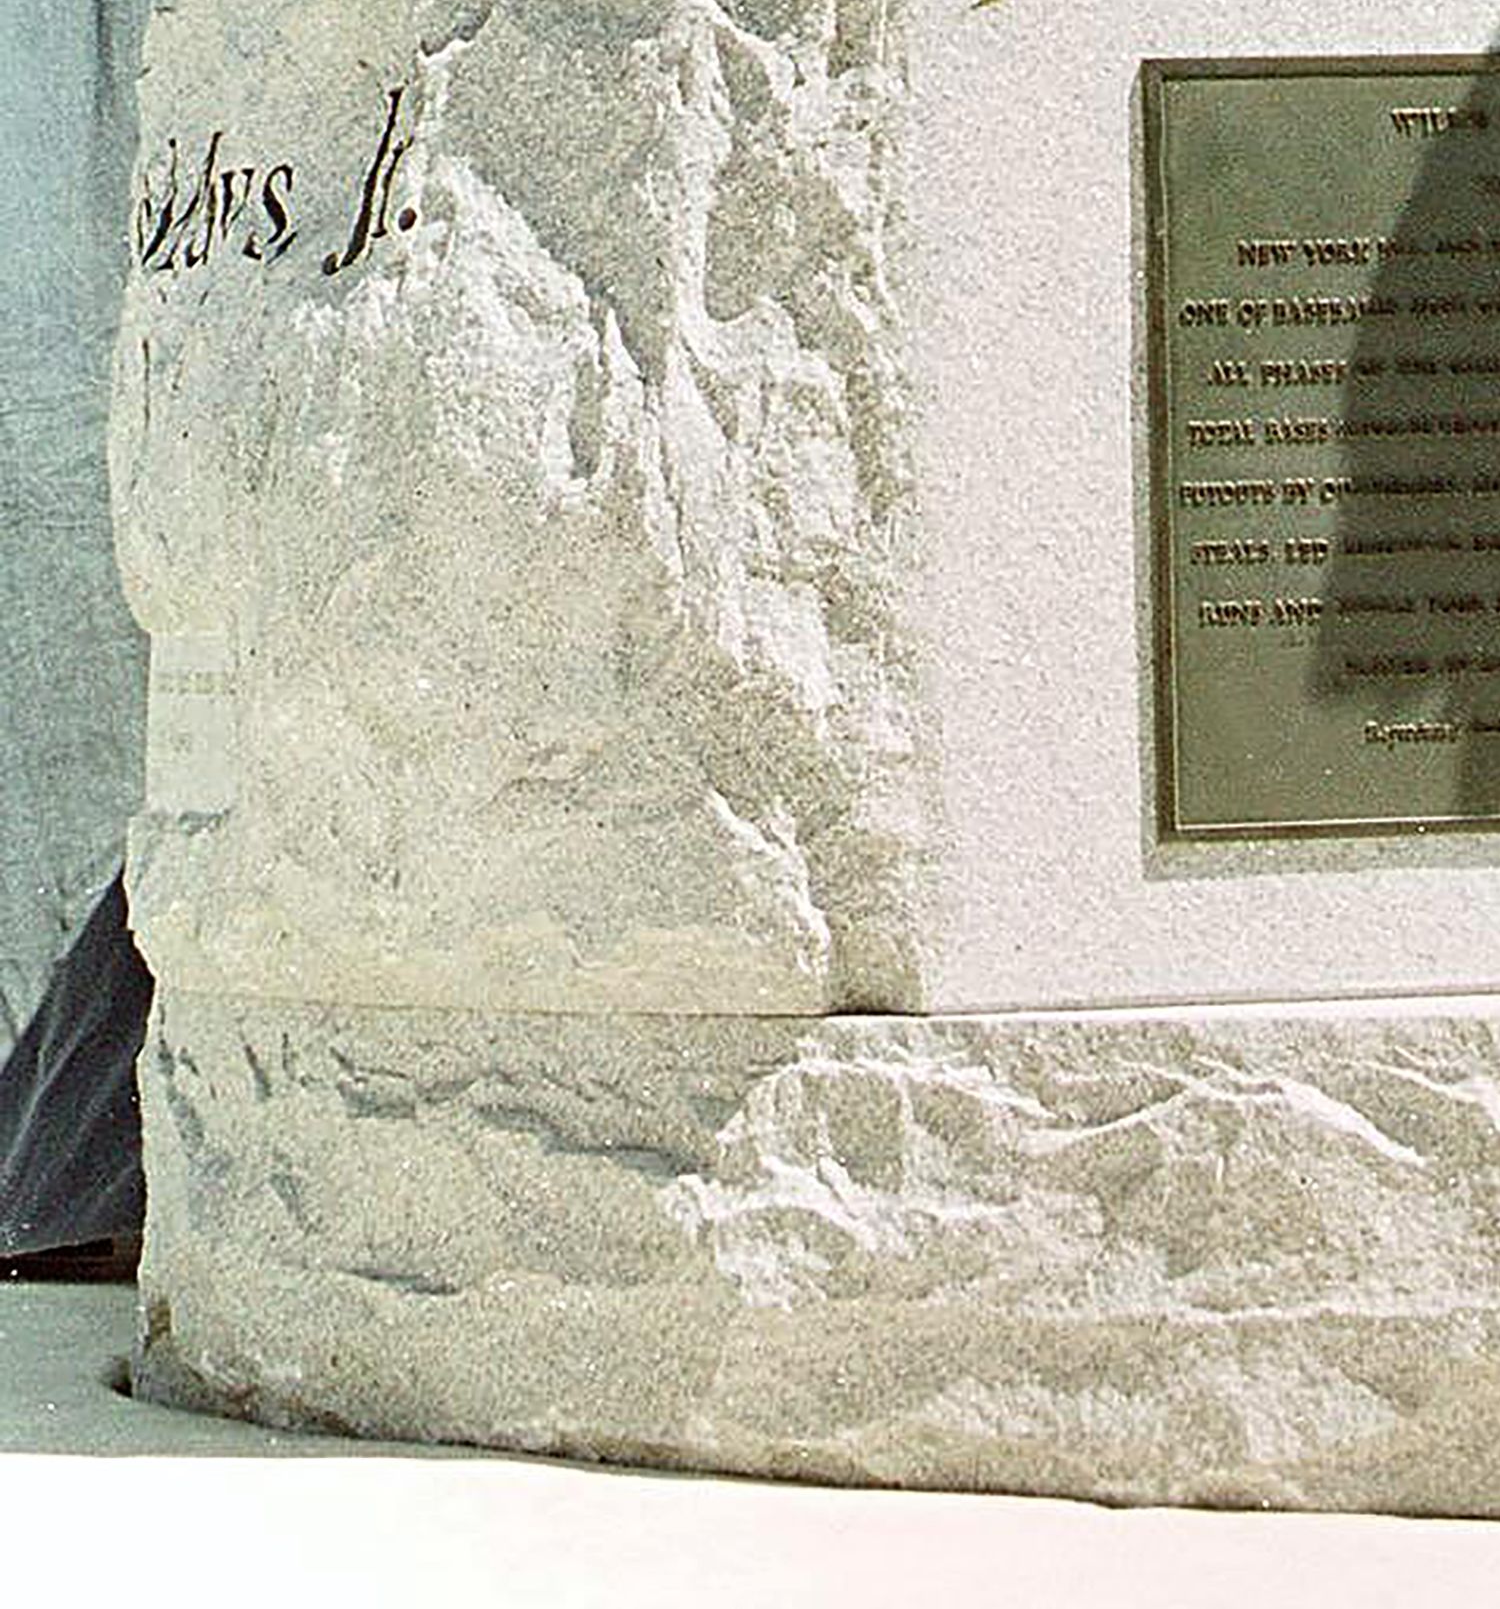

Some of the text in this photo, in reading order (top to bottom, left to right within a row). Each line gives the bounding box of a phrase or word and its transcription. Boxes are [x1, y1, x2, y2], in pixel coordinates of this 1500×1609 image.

[1237, 238, 1298, 268] NEW
[1301, 237, 1371, 268] YORK
[1179, 297, 1229, 328] ONE
[1235, 297, 1269, 328] OF
[1188, 419, 1255, 447] TOTAL
[1264, 417, 1330, 446] BASES
